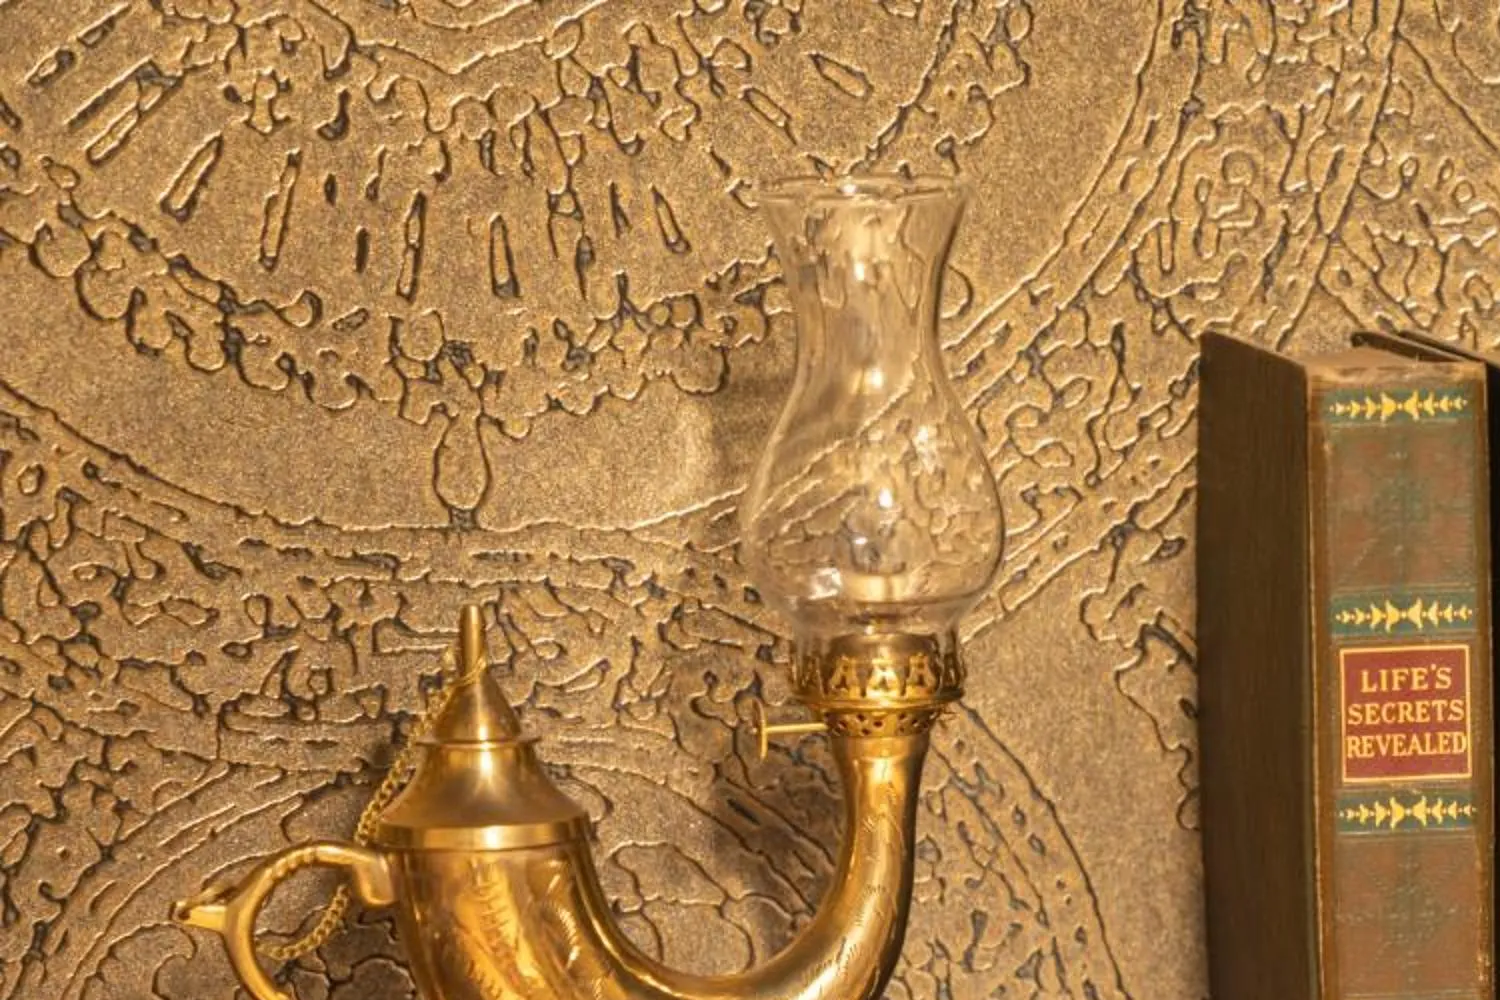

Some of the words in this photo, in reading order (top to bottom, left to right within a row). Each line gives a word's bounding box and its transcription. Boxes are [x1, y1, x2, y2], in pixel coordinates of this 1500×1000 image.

[1360, 664, 1452, 692] LIFE'S
[1348, 700, 1465, 725] SECRETS
[1346, 731, 1467, 758] REVEALED
